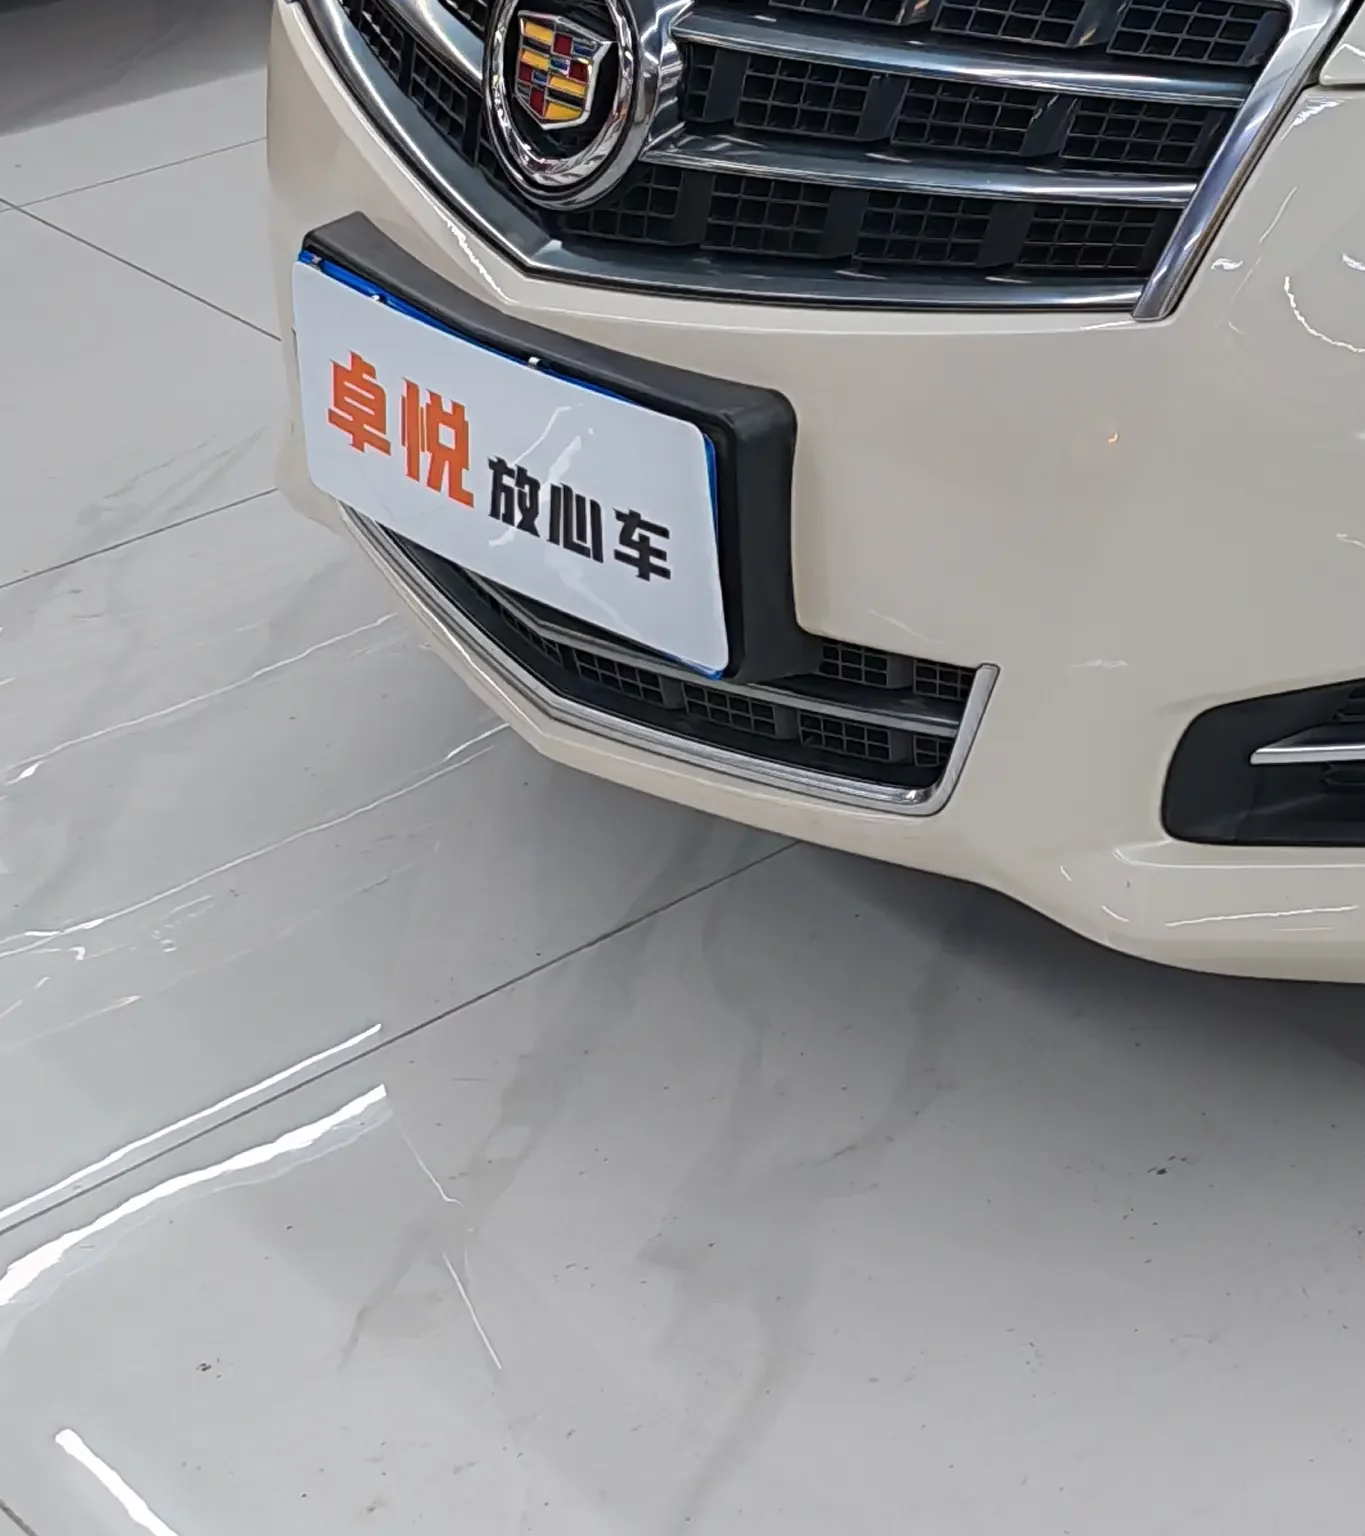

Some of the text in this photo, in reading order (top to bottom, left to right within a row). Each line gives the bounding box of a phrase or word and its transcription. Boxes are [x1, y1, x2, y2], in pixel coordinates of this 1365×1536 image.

[328, 349, 672, 582] 卓悦 放心车
